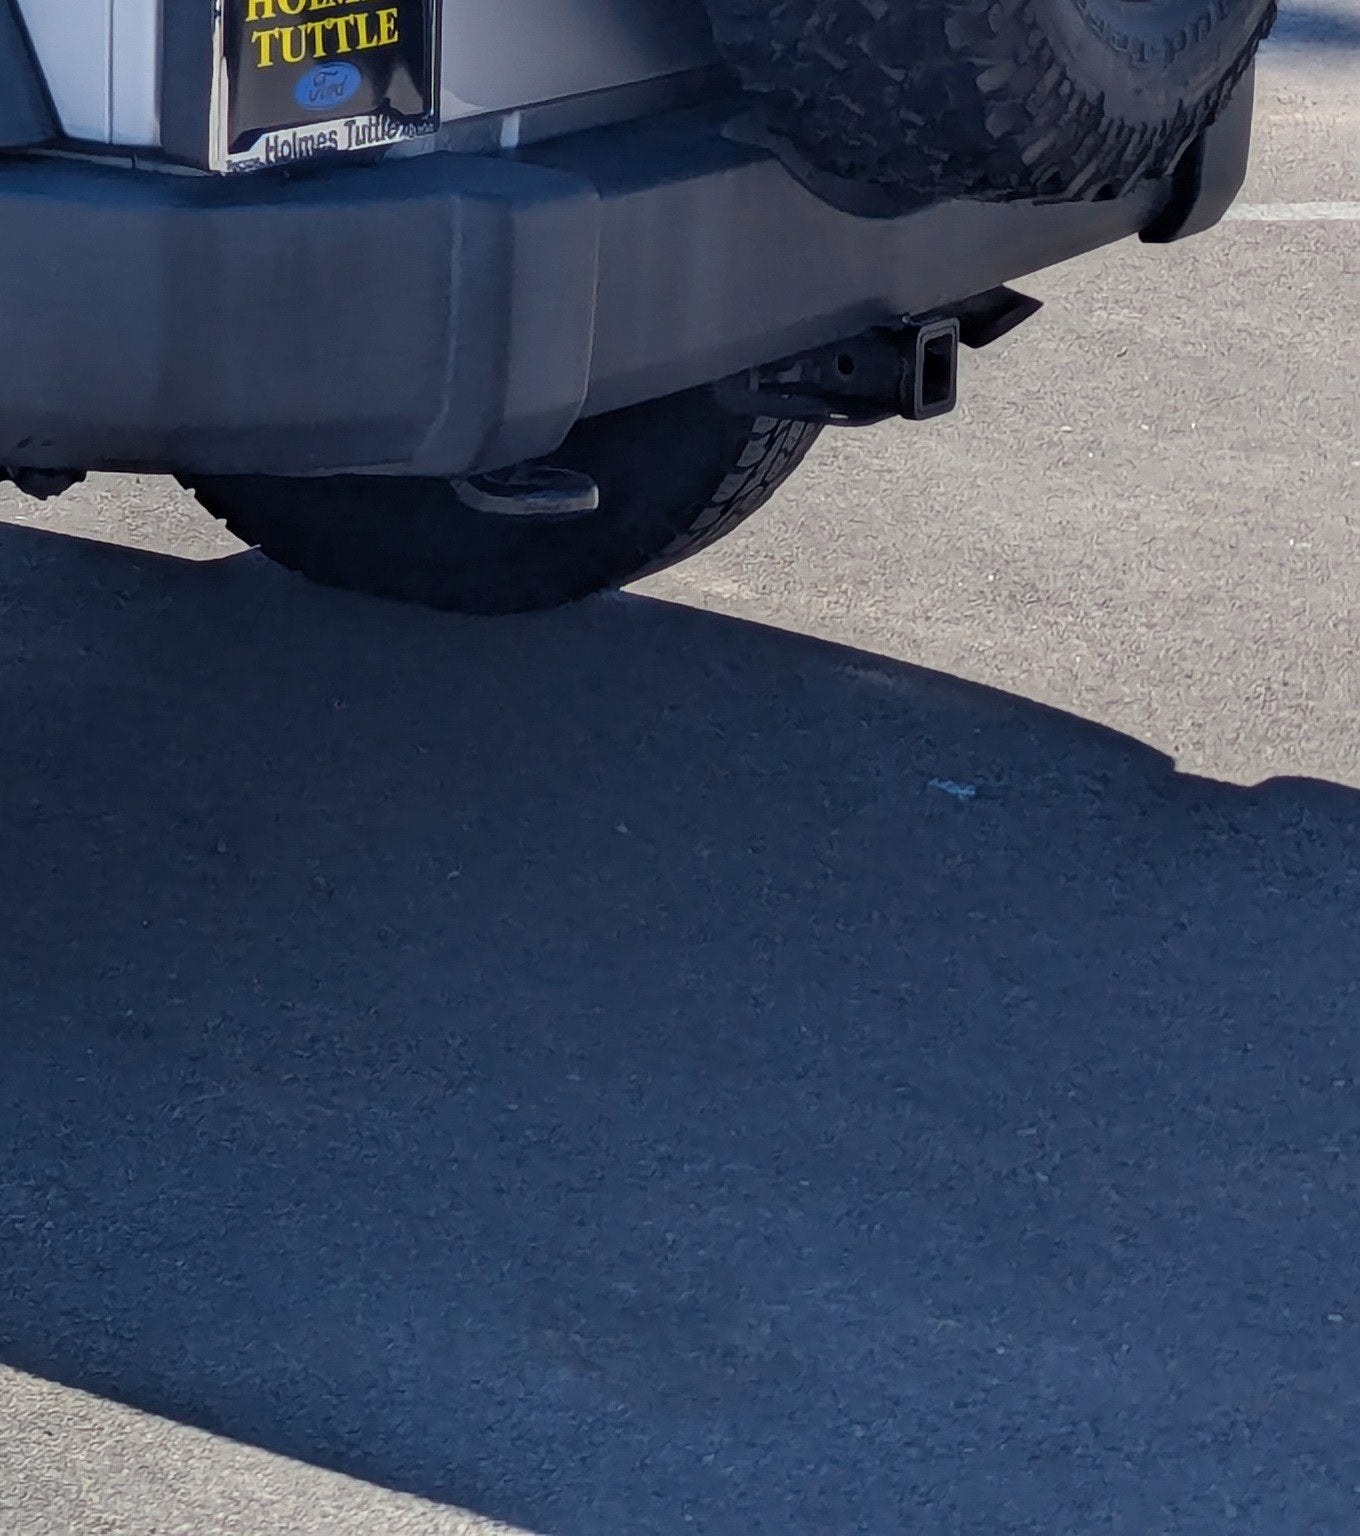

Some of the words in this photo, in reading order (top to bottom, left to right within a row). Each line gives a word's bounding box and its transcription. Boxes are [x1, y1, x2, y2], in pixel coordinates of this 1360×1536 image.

[251, 7, 400, 68] TUTTLE
[309, 69, 348, 102] Ford
[265, 128, 339, 161] Holmes
[344, 114, 399, 149] Tuttle
